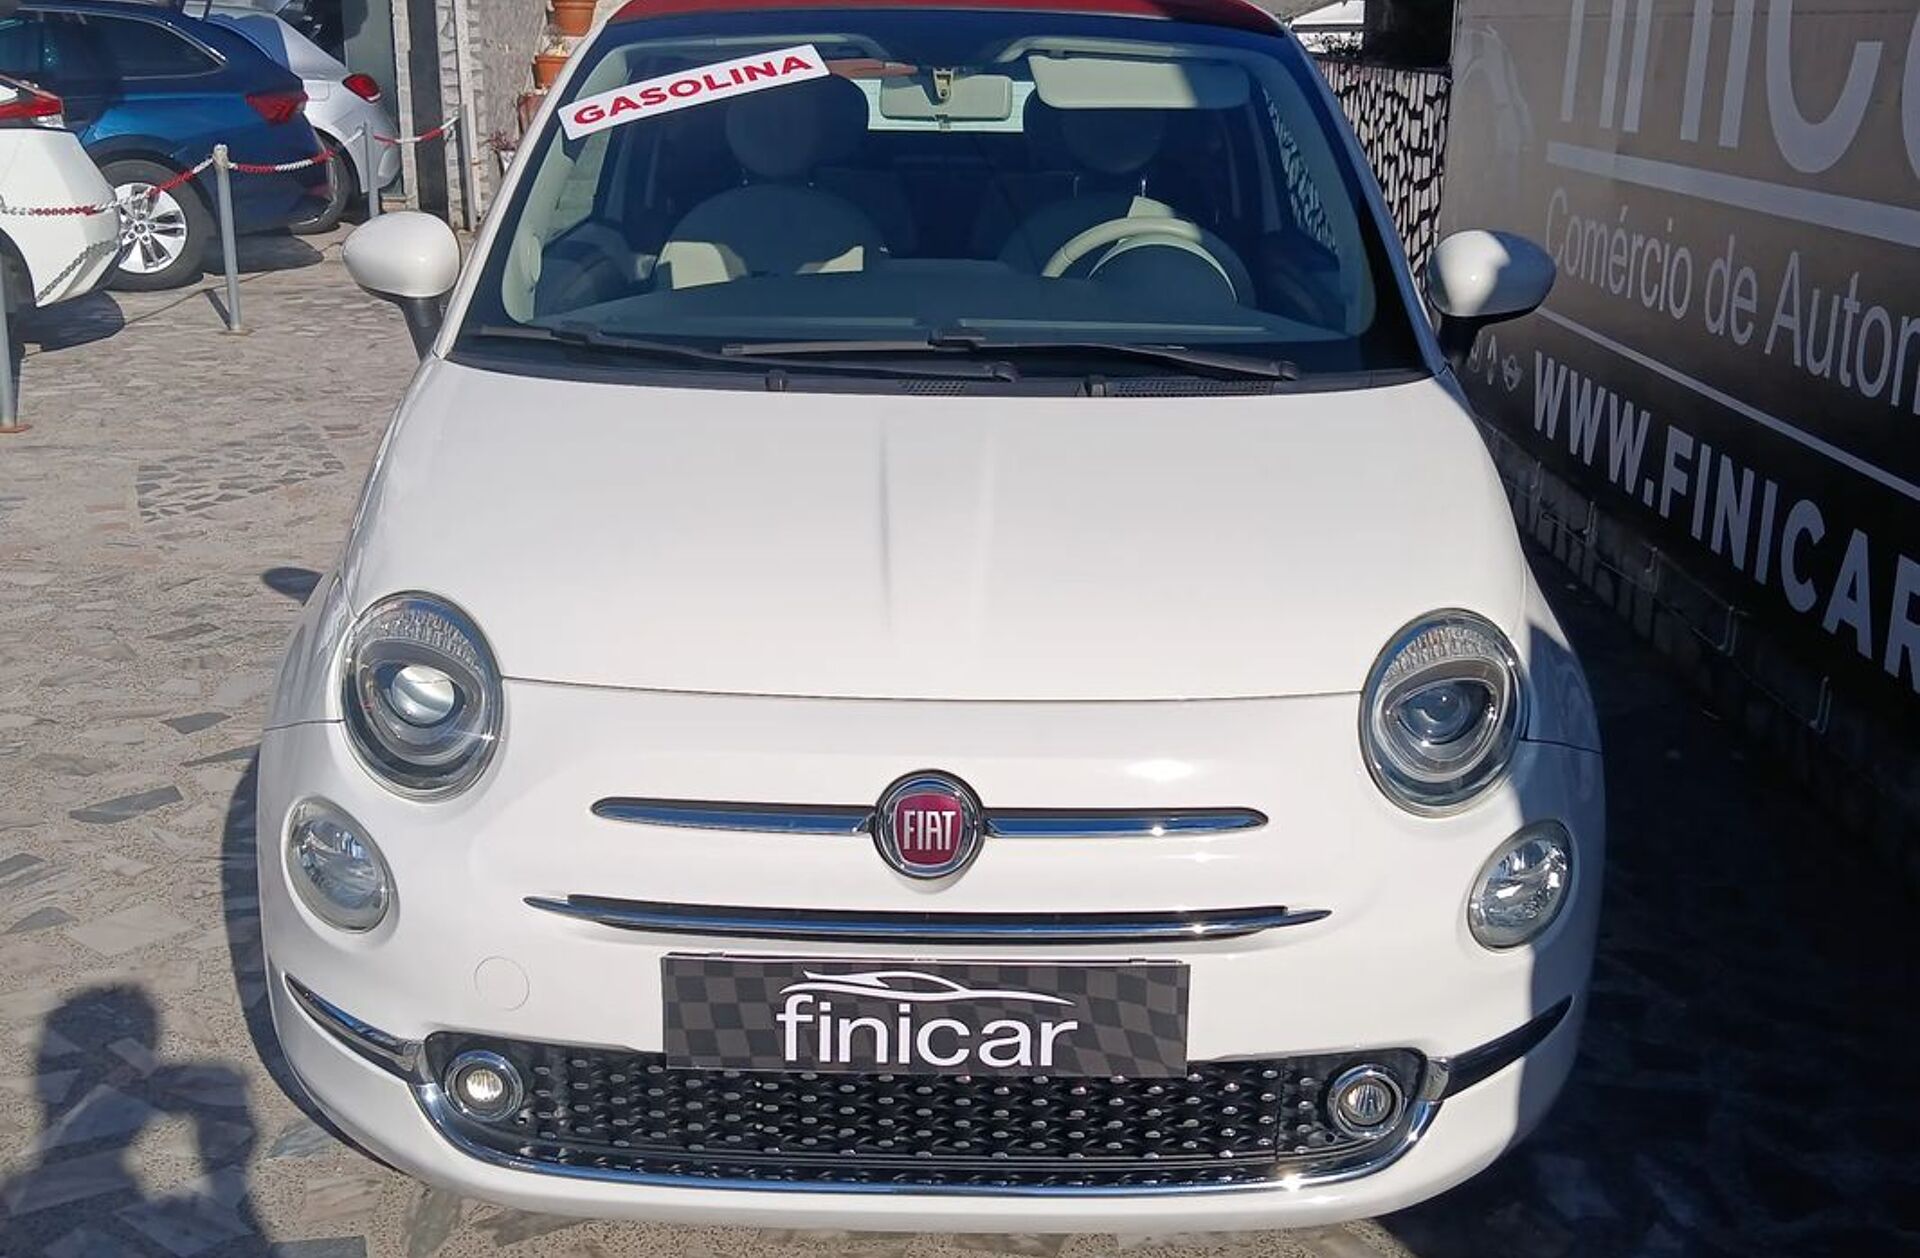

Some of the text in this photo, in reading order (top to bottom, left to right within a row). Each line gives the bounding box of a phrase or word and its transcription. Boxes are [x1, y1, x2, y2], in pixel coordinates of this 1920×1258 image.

[574, 56, 812, 124] GASOLINA
[1546, 187, 1693, 320] Comércio
[1704, 235, 1758, 347] de
[902, 809, 956, 851] FIAT
[776, 994, 1078, 1067] finicar
